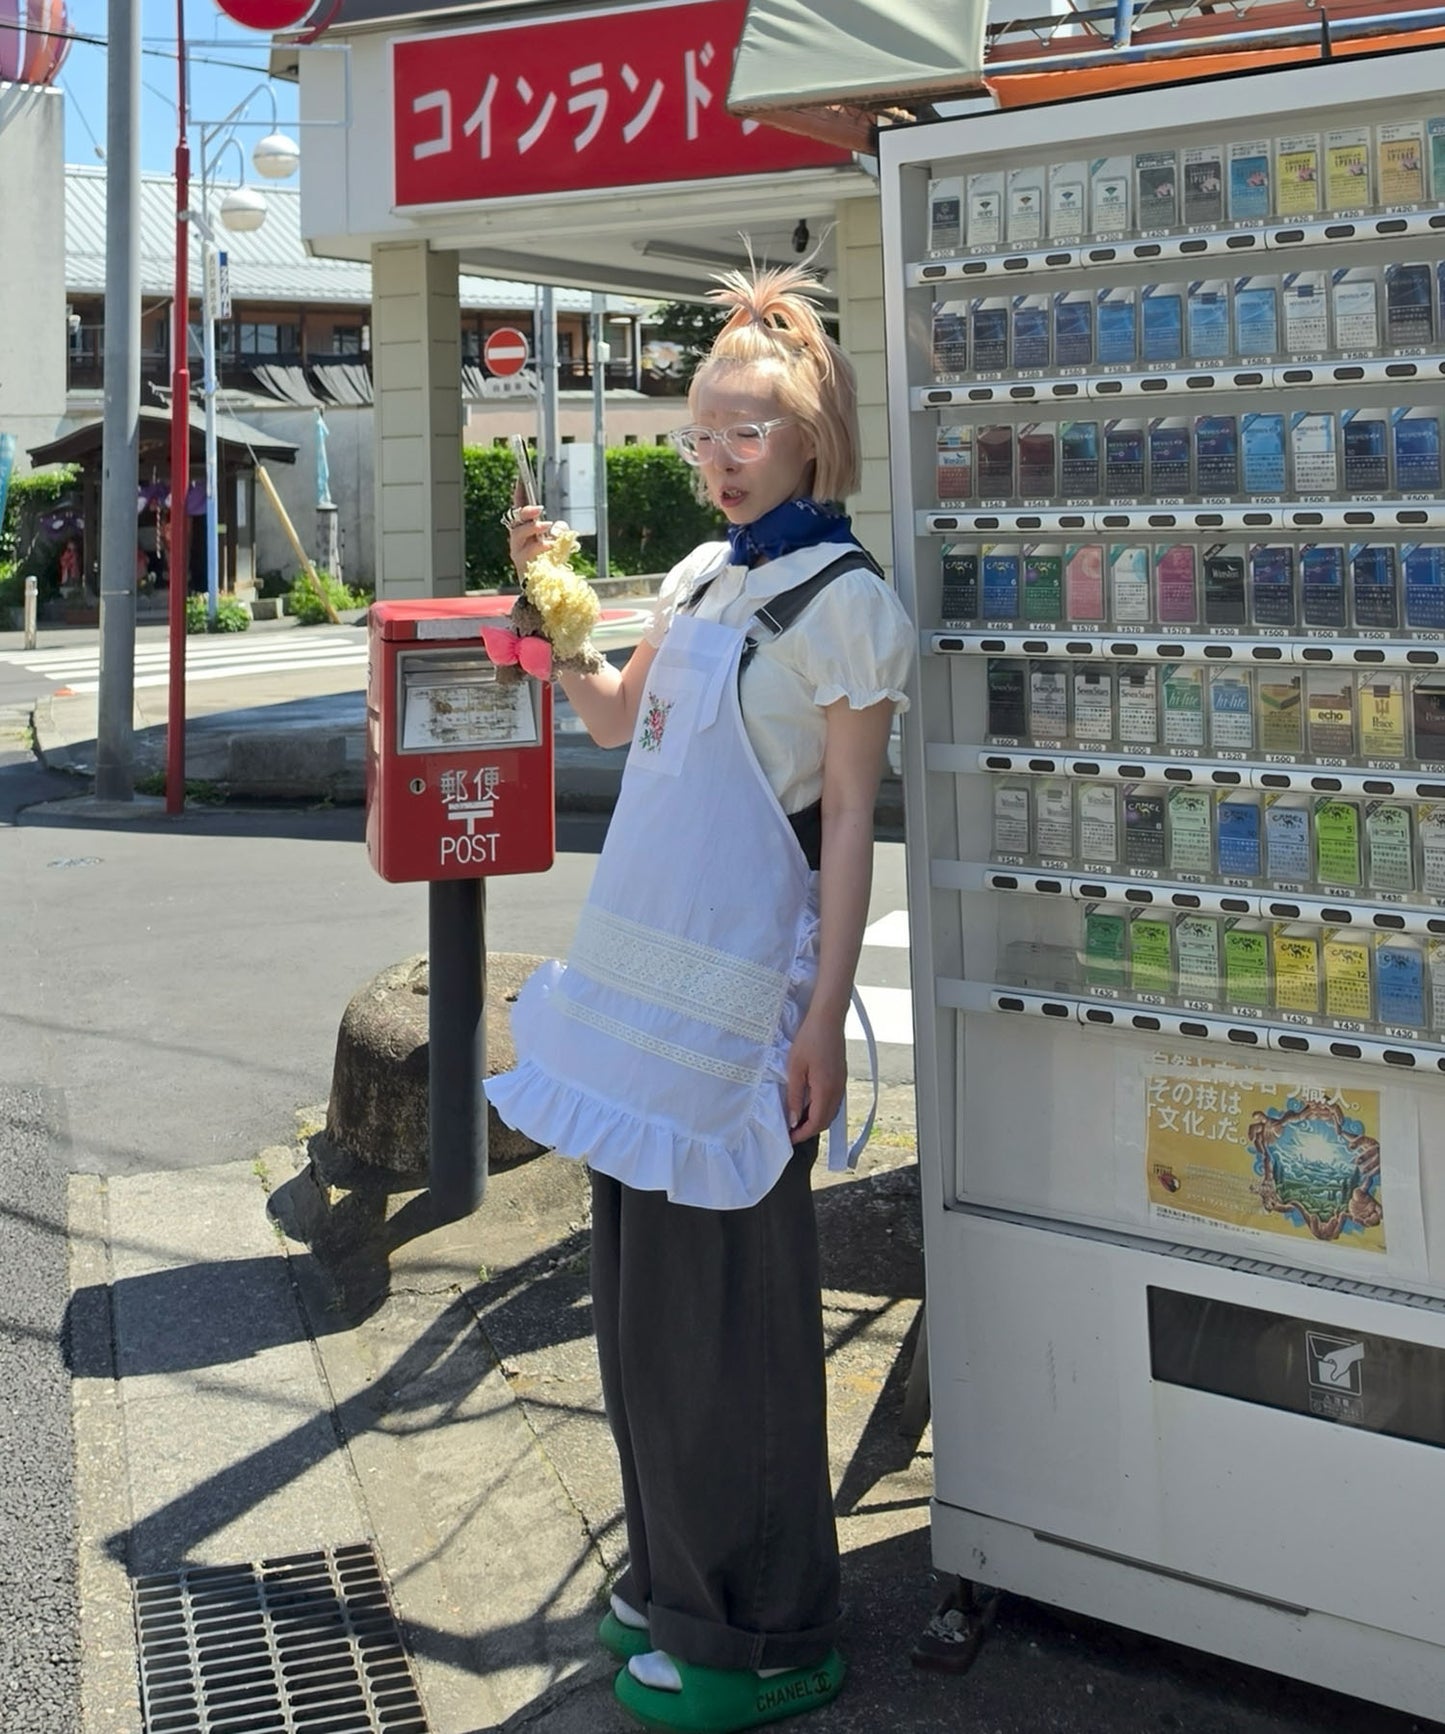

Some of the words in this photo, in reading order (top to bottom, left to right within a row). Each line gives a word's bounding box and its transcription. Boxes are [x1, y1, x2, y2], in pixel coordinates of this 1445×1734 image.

[412, 40, 762, 161] コインランド
[1338, 210, 1360, 218] ¥420
[1391, 206, 1413, 214] ¥420
[1347, 351, 1369, 359] ¥580
[1399, 348, 1421, 356] ¥580
[1297, 354, 1318, 362] ¥580
[945, 561, 973, 570] CAMEL
[986, 561, 1016, 570] CAMEL
[1028, 561, 1058, 570] CAMEL
[1312, 631, 1334, 639] ¥500
[1363, 632, 1386, 640] ¥500
[1417, 633, 1440, 641] ¥500
[1169, 692, 1198, 707] hi-lite
[1216, 694, 1247, 708] hi-lite
[1318, 710, 1344, 721] echo
[1372, 716, 1394, 728] Peace
[1271, 755, 1291, 763] ¥500
[1321, 758, 1343, 767] ¥500
[1373, 760, 1396, 769] ¥600
[440, 766, 501, 804] 郵便
[1174, 797, 1206, 807] CAMEL
[1128, 802, 1161, 813] CAMEL
[1322, 805, 1351, 815] CAMEL
[1272, 813, 1304, 824] CAMEL
[1373, 809, 1403, 820] CAMEL
[1346, 825, 1353, 833] 5
[1400, 829, 1405, 838] 1
[440, 833, 501, 866] POST
[1228, 879, 1249, 887] ¥430
[1329, 889, 1350, 897] ¥430
[1136, 926, 1165, 937] CAMEL
[1183, 921, 1213, 933] CAMEL
[1210, 943, 1215, 952] 1
[1231, 937, 1262, 948] CAMEL
[1280, 942, 1312, 954] CAMEL
[1331, 948, 1363, 960] CAMEL
[1304, 964, 1315, 973] 14
[1356, 970, 1367, 979] 12
[1095, 987, 1114, 997] ¥430
[1142, 994, 1162, 1004] ¥430
[1188, 1001, 1210, 1010] ¥430
[1237, 1007, 1258, 1017] ¥430
[1287, 1014, 1308, 1024] ¥430
[1338, 1021, 1361, 1031] ¥430
[1390, 1028, 1414, 1039] ¥430
[1150, 1079, 1242, 1115] その技は
[1147, 1103, 1249, 1146] 「文化」だ。
[756, 1680, 813, 1713] CHANEL
